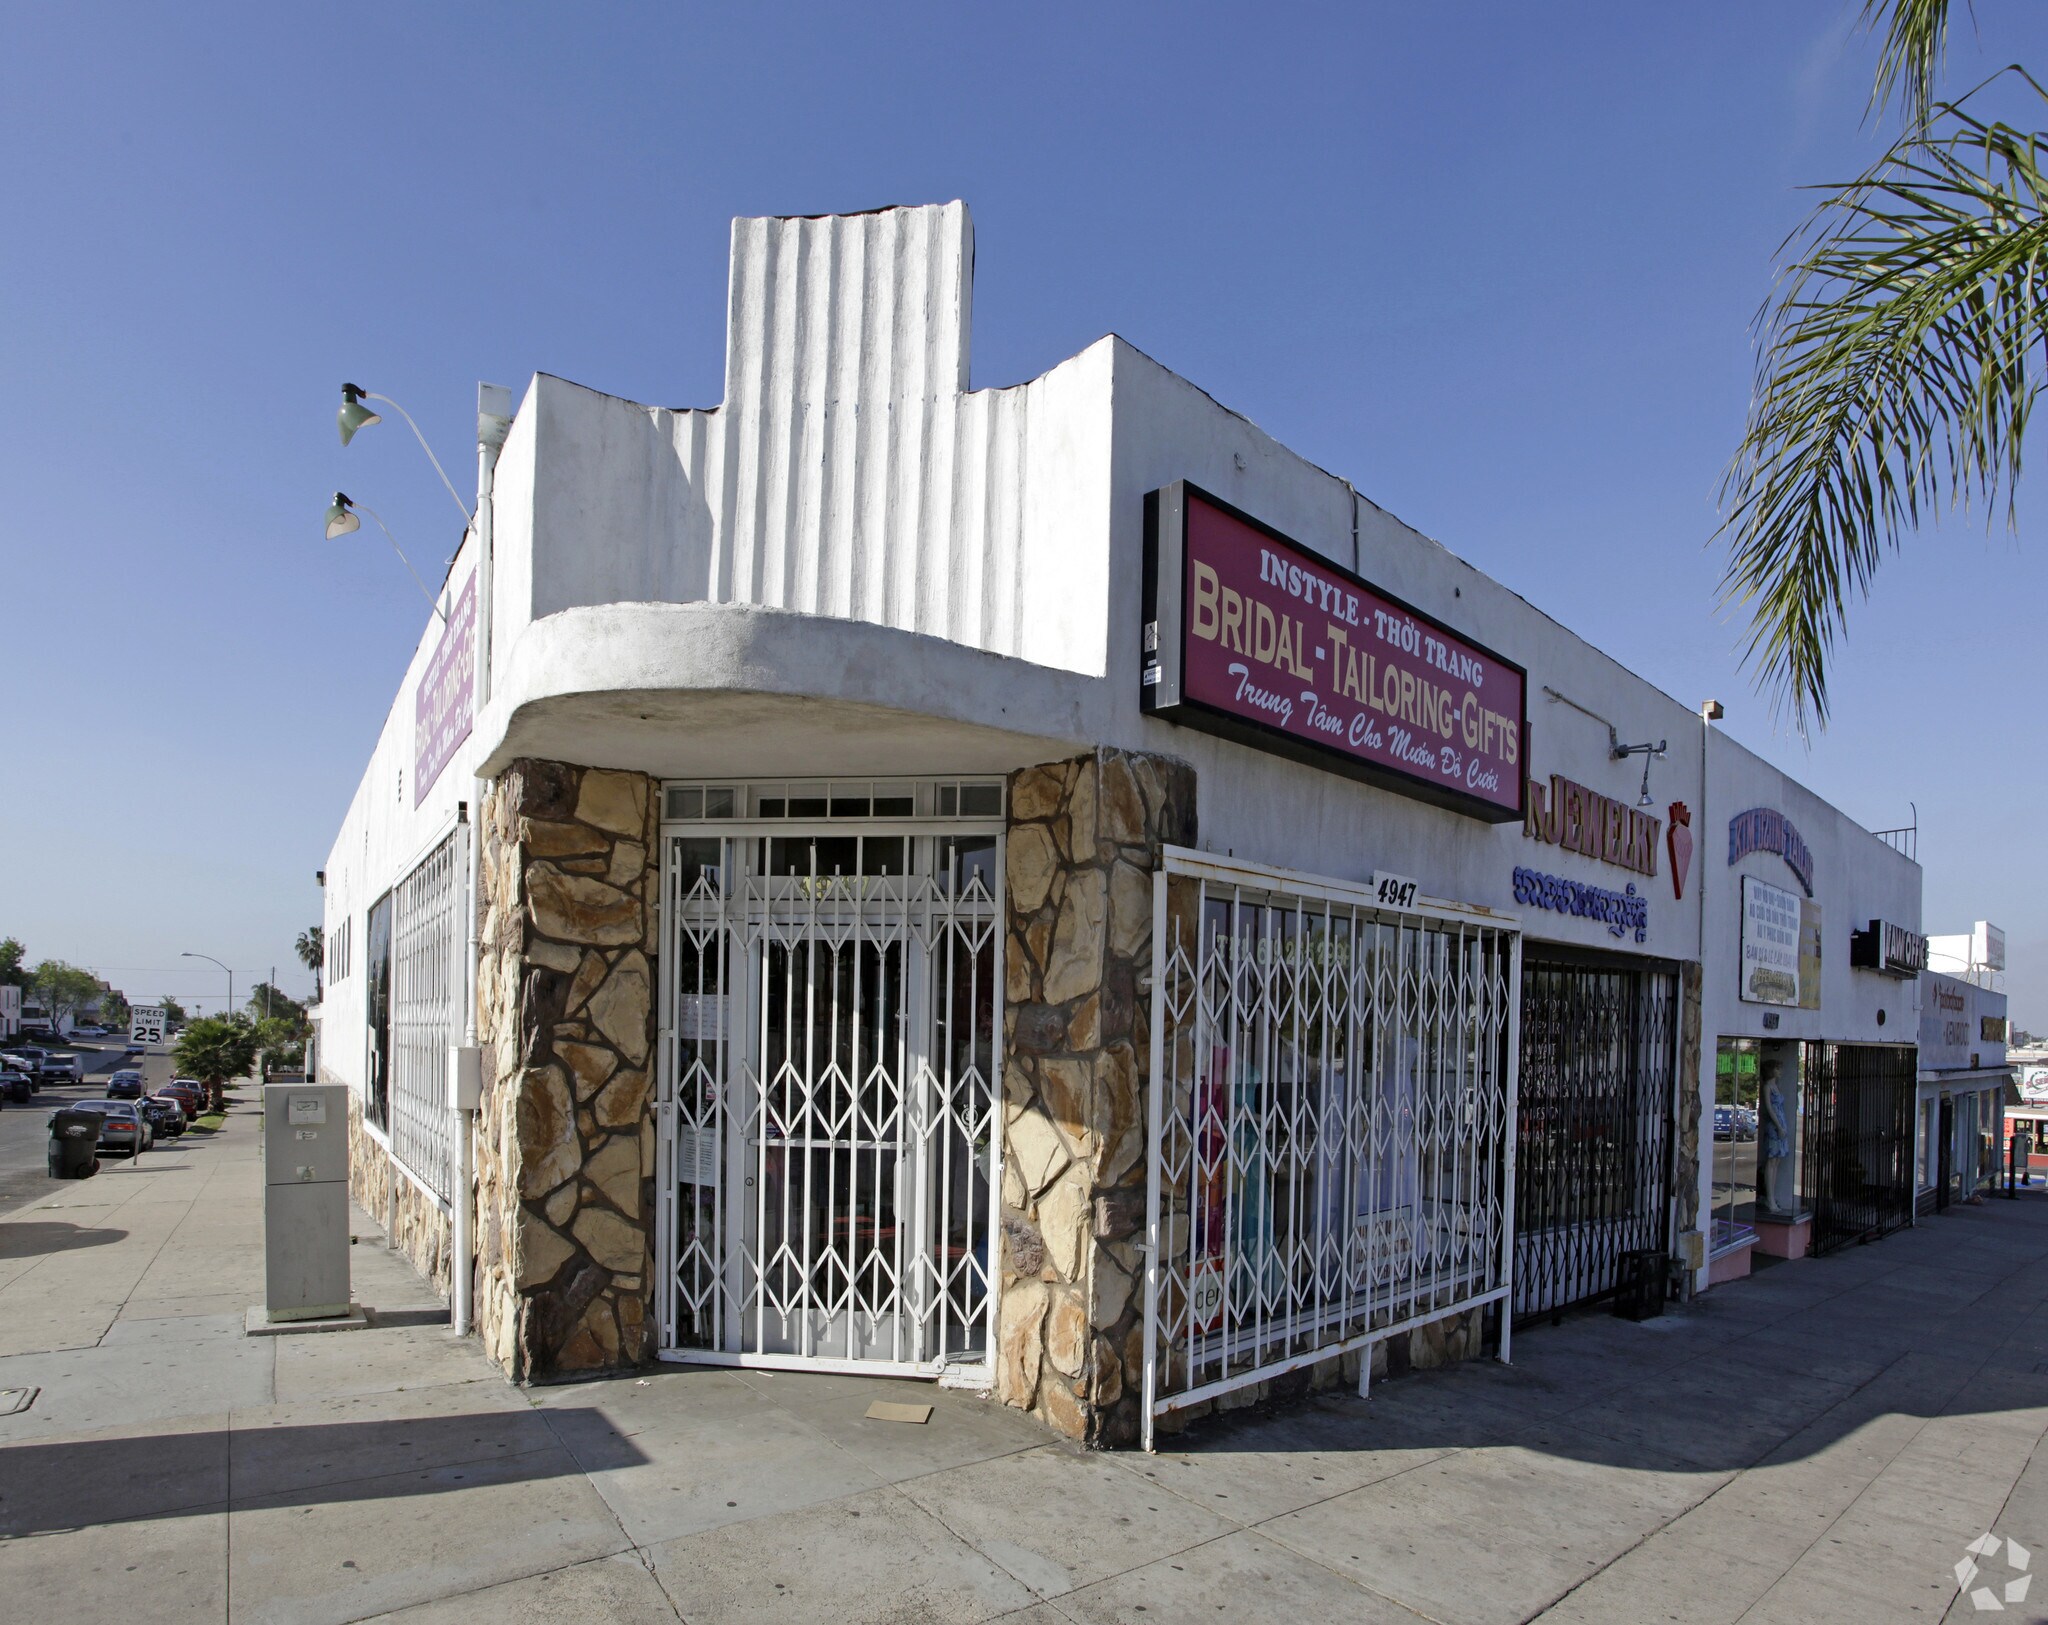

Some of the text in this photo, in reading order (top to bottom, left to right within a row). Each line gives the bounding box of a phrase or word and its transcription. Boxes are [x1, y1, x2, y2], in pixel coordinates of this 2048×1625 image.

[1259, 548, 1359, 626] INSTYLE
[1424, 635, 1484, 689] TRANG
[1227, 661, 1294, 728] Trung
[1299, 690, 1345, 737] Tâm
[1347, 711, 1383, 750] Cho
[1543, 774, 1662, 876] JEWELRY
[1377, 878, 1417, 908] 4947
[1885, 922, 1906, 962] LAW
[134, 1008, 165, 1018] SPEED
[136, 1017, 161, 1027] LIMIT
[133, 1026, 161, 1043] 25
